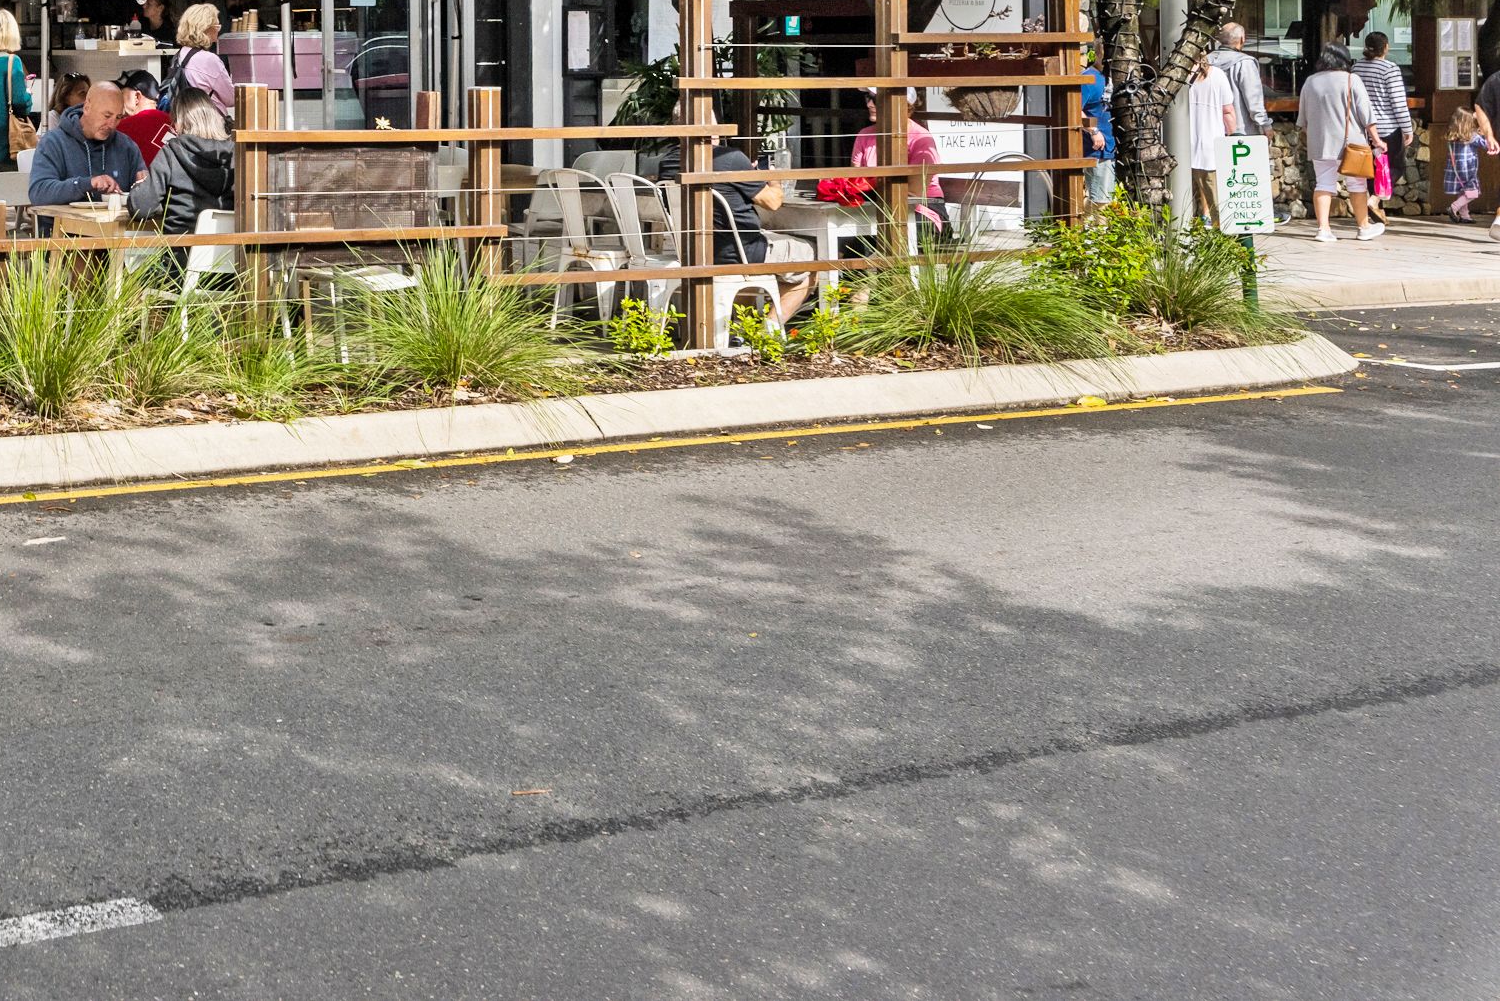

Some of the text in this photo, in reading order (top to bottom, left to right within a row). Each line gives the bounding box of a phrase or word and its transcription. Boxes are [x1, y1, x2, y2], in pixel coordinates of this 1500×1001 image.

[940, 135, 998, 148] TAKE AWAY
[1232, 144, 1251, 166] P
[1229, 190, 1259, 199] MOTOR
[1227, 201, 1262, 210] CYCLES
[1233, 211, 1257, 219] ONLY
